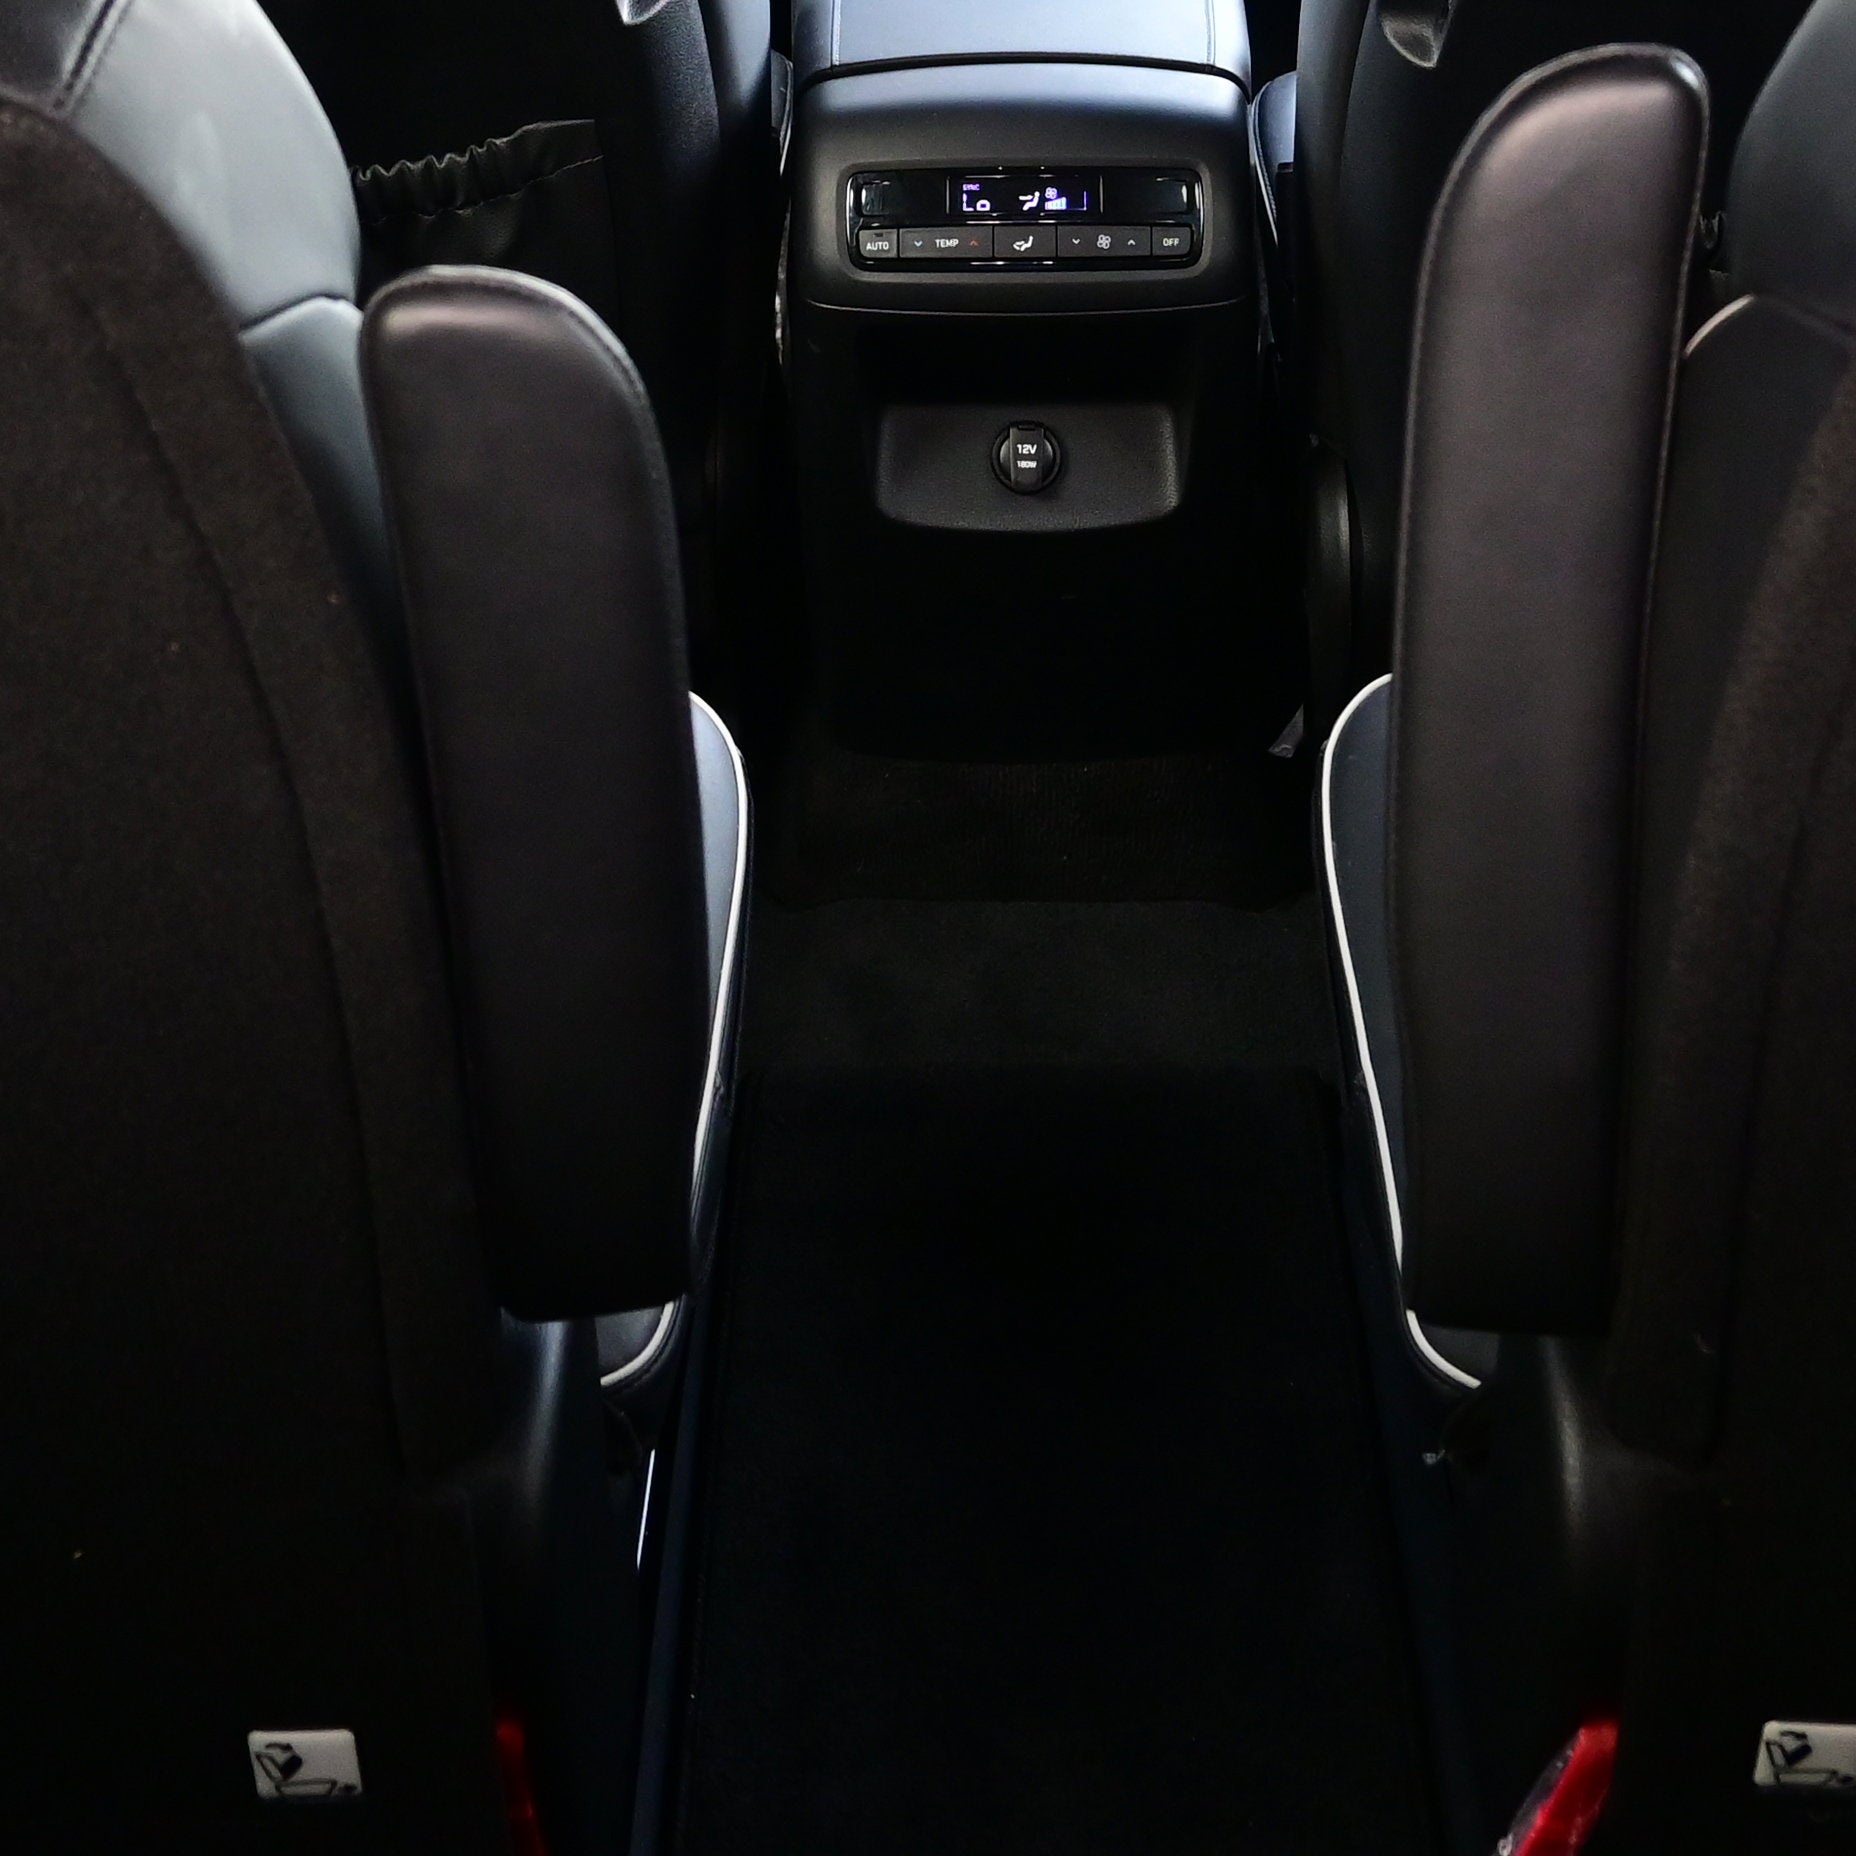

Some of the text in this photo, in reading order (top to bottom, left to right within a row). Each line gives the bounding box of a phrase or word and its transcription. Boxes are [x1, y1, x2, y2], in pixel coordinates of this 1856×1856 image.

[866, 241, 889, 251] AUTO
[935, 238, 959, 248] TEMP
[1162, 237, 1180, 247] OFF
[1016, 444, 1037, 454] 12V
